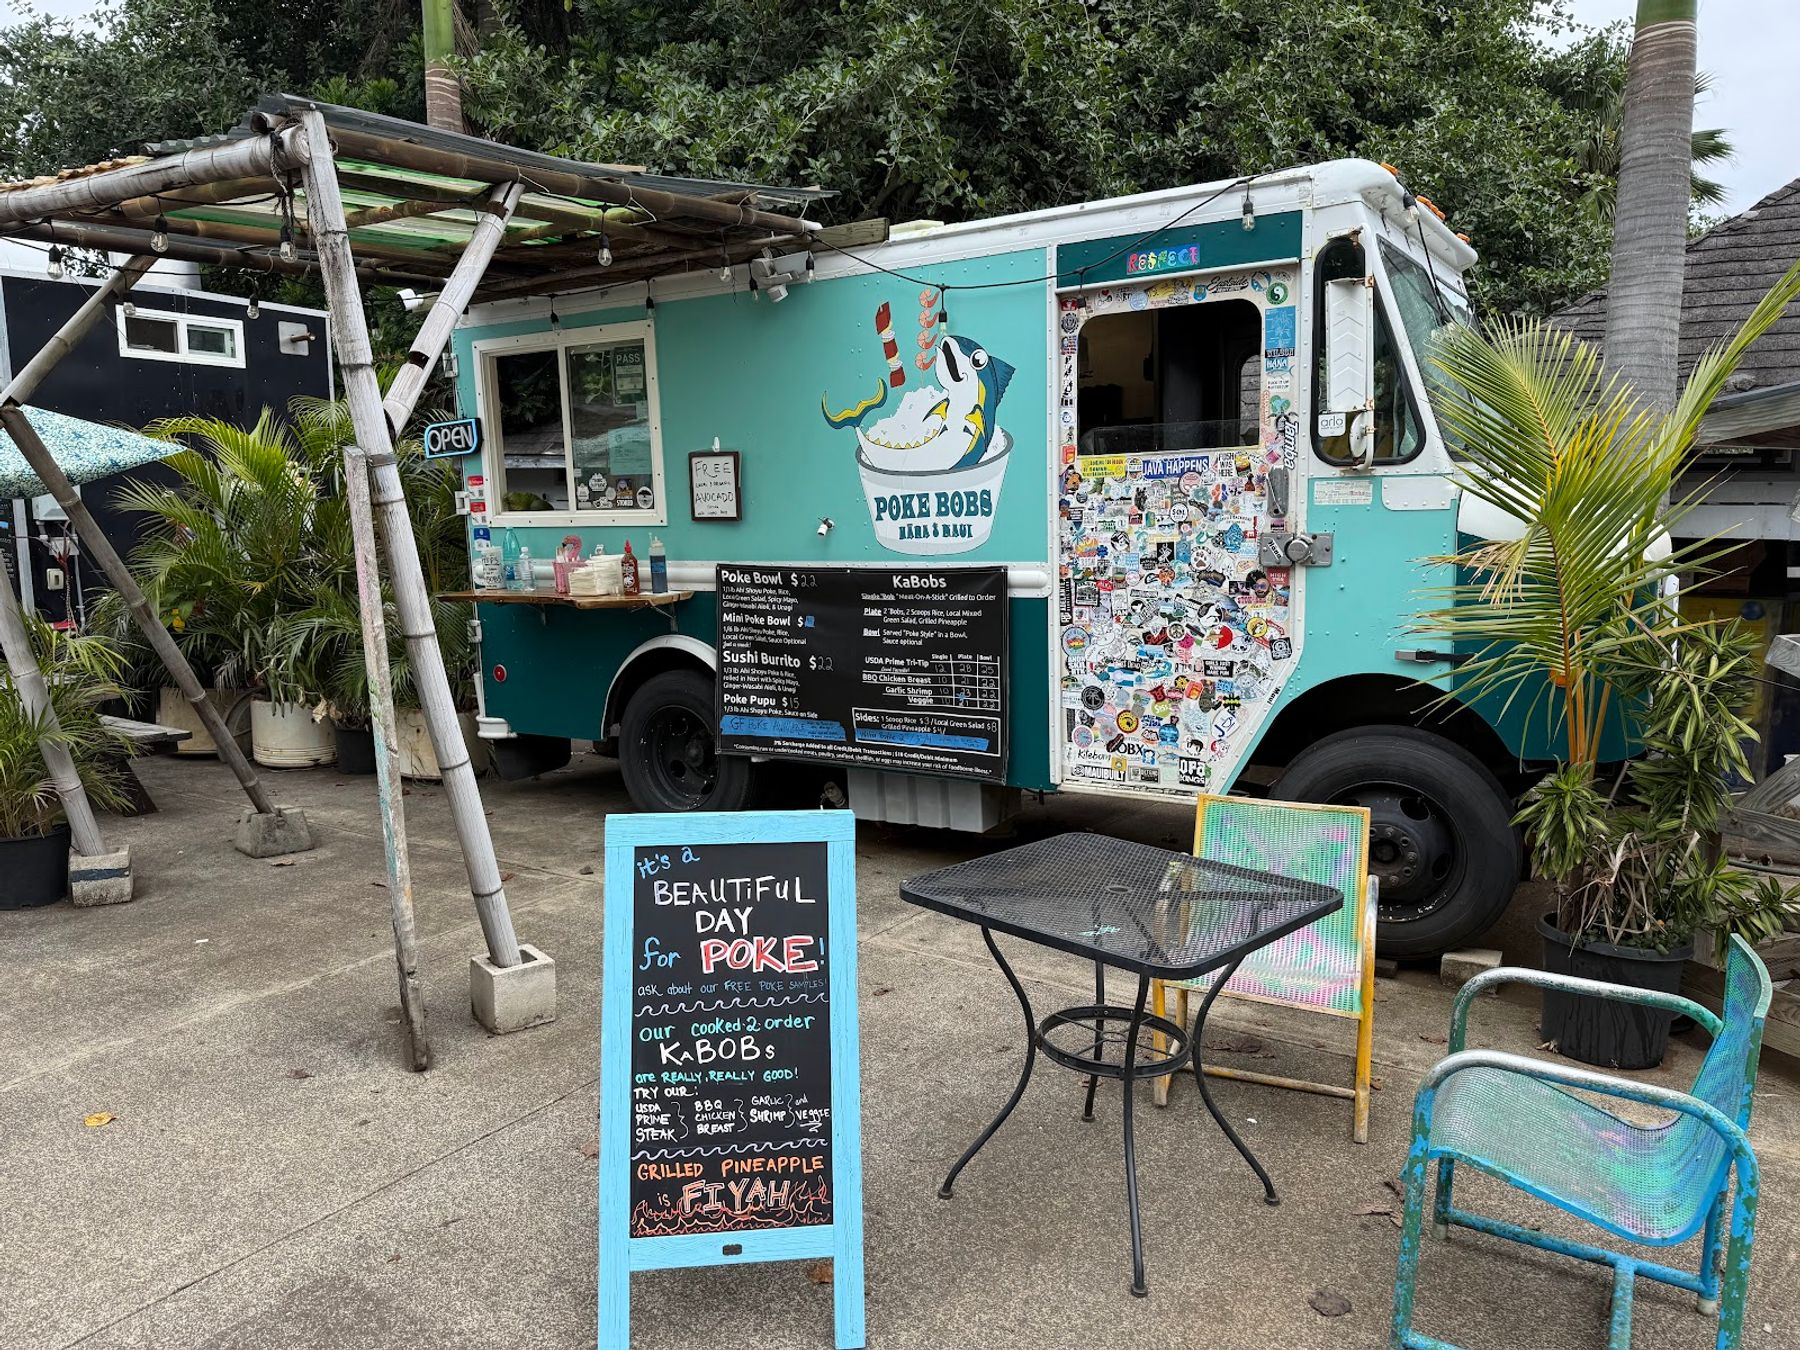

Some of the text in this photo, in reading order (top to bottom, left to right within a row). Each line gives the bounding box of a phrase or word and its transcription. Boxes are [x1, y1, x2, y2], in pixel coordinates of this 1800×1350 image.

[616, 353, 641, 364] PASS
[1320, 416, 1344, 428] arlo
[428, 425, 473, 452] OPEN
[1284, 420, 1299, 470] Tamba
[695, 461, 731, 478] FREE
[1142, 460, 1164, 476] JAVA
[1167, 456, 1209, 475] HAPPENS
[695, 492, 734, 504] AVOCADO
[874, 489, 993, 521] POKE BOBS
[942, 523, 973, 538] MAUI
[721, 570, 751, 583] Poke
[753, 572, 783, 585] Bowl
[892, 573, 948, 589] KaBobs
[864, 607, 882, 616] Plate
[910, 609, 931, 617] Scoops
[932, 609, 945, 617] Rice,
[723, 612, 744, 623] Mini
[744, 614, 765, 626] Poke
[767, 615, 791, 627] Bowl
[918, 617, 937, 625] Grilled
[938, 618, 968, 626] Pineapple
[863, 628, 880, 636] Bowl
[883, 629, 902, 637] Served
[783, 637, 807, 646] Optional
[882, 637, 923, 646] Sauce optional
[723, 650, 759, 664] Sushi
[760, 653, 801, 669] Burrito
[865, 656, 995, 675] USDA Prime Tri-Tip 12 28 25
[862, 673, 878, 683] BBQ
[879, 673, 906, 683] Chicken
[907, 676, 932, 684] Breast
[938, 676, 948, 684] 10
[981, 678, 996, 688] 22
[885, 686, 906, 694] Garlic
[906, 687, 933, 698] Shrimp
[940, 687, 950, 695] 10
[981, 689, 997, 699] 22
[723, 693, 748, 705] Poke
[750, 695, 776, 707] Pupu
[907, 696, 934, 706] Veggie
[724, 705, 734, 713] 1/3
[784, 709, 799, 717] Sauce
[807, 711, 818, 719] Side
[855, 713, 880, 723] Sides:
[885, 716, 904, 724] Scoop
[950, 720, 967, 728] Green
[967, 721, 985, 729] Salad
[881, 723, 931, 734] Grilled Pineapple
[637, 847, 700, 879] it's a
[695, 906, 753, 935] DAY
[639, 937, 681, 971] for
[638, 984, 663, 997] ask
[667, 983, 693, 995] about
[700, 983, 718, 994] our
[724, 979, 752, 993] FREE
[759, 980, 784, 992] POKE
[639, 1026, 675, 1042] our
[764, 1014, 815, 1030] order
[635, 1072, 656, 1084] are
[633, 1087, 659, 1098] TRY
[695, 1100, 723, 1112] BBQ
[751, 1095, 785, 1106] GARLIC
[635, 1103, 661, 1114] USDA
[750, 1108, 787, 1123] SHRIMP
[635, 1113, 671, 1126] PRIME
[695, 1111, 736, 1122] CHICKEN
[635, 1128, 678, 1142] STEAK
[696, 1123, 735, 1135] BREAST
[637, 1155, 825, 1181] GRILLED PINEAPPLE
[682, 1177, 790, 1214] FIYAH
